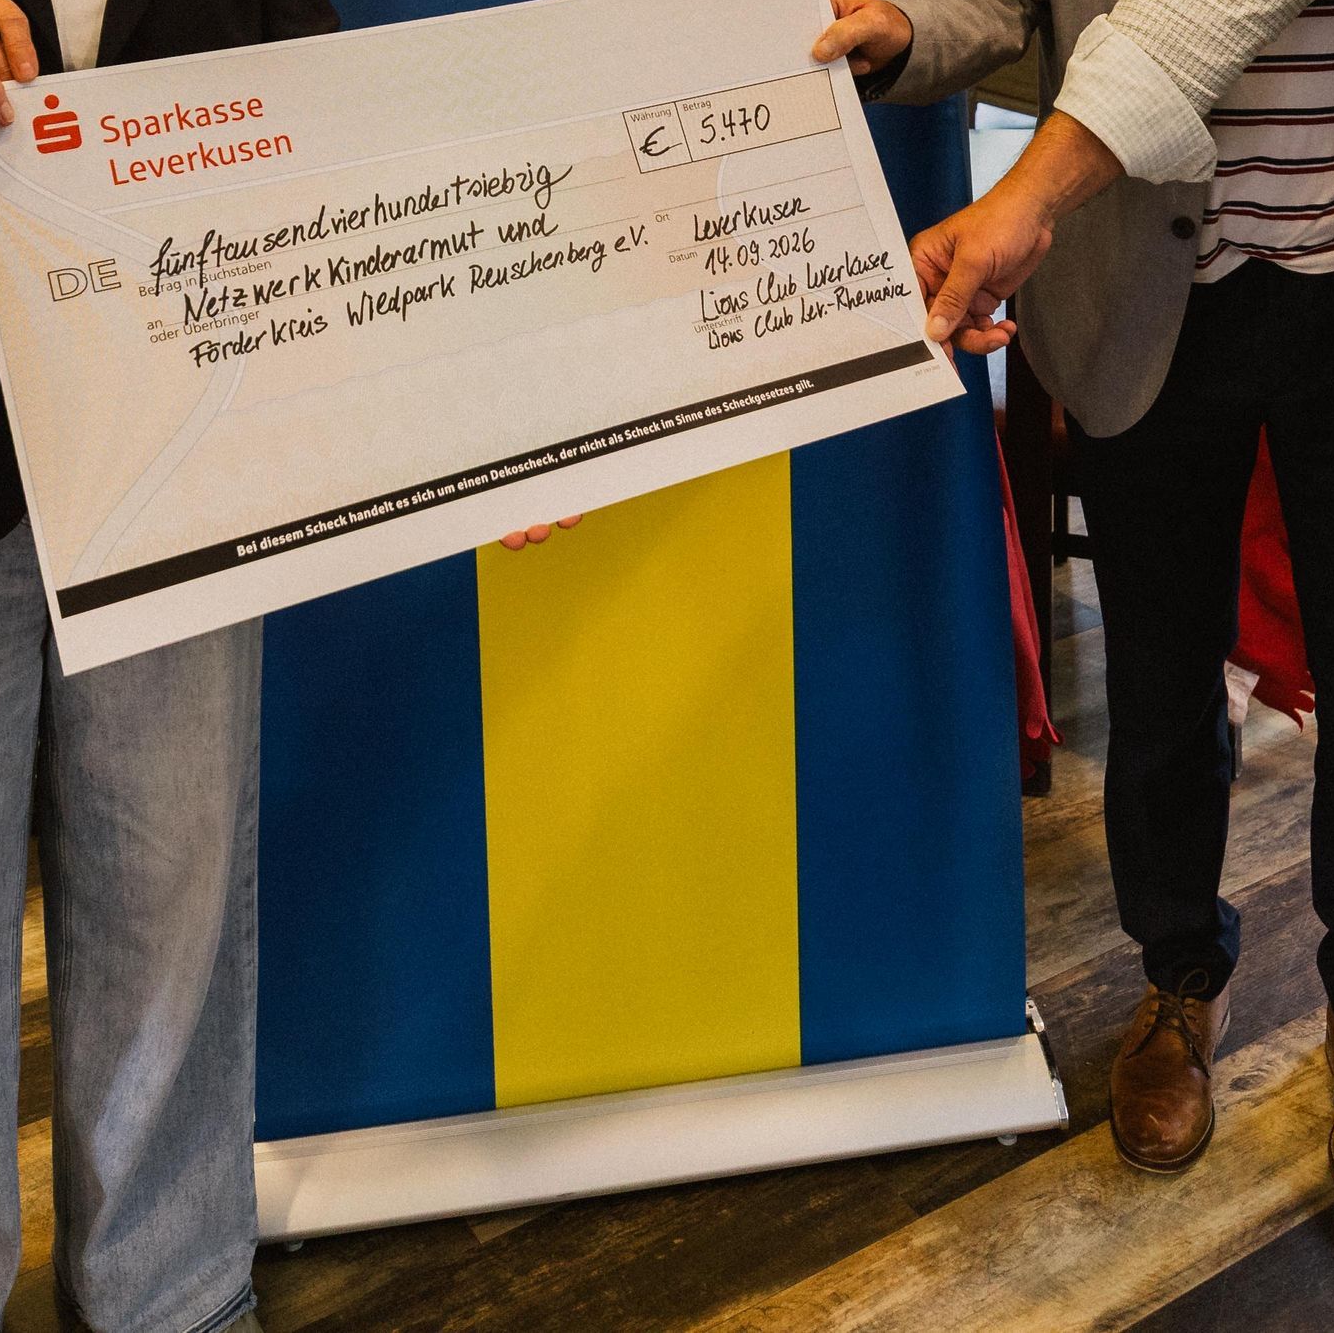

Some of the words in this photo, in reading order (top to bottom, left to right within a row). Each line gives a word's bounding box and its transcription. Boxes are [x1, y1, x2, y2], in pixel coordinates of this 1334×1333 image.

[683, 100, 712, 112] Betrag
[100, 97, 264, 147] Sparkasse
[700, 104, 771, 144] 5.470
[109, 133, 293, 186] Leverkusen
[497, 213, 559, 243] und
[655, 213, 671, 223] Ort
[668, 252, 699, 264] Datum
[48, 258, 122, 302] DE
[185, 276, 198, 288] in
[200, 260, 272, 284] Buchstaben
[700, 289, 749, 323] Lions
[756, 271, 798, 305] Club
[146, 319, 163, 330] an
[149, 329, 179, 344] oder
[694, 314, 744, 333] Unterschrift
[708, 329, 744, 350] Lions
[754, 306, 794, 338] Club
[236, 539, 258, 557] Bei
[259, 527, 304, 550] diesem
[305, 515, 348, 537] Scheck
[348, 501, 395, 524] handelt
[395, 497, 410, 510] es
[411, 489, 436, 507] sich
[436, 484, 456, 498] um
[457, 473, 489, 491] einen
[490, 452, 559, 481] Dekoscheck,
[559, 446, 578, 460] der
[579, 437, 607, 455] nicht
[608, 432, 624, 446] als
[624, 421, 661, 441] Scheck
[660, 416, 675, 430] im
[675, 410, 704, 426] Sinne
[704, 405, 723, 418] des
[722, 384, 795, 412] Scheckgesetzes
[795, 379, 815, 394] gilt.
